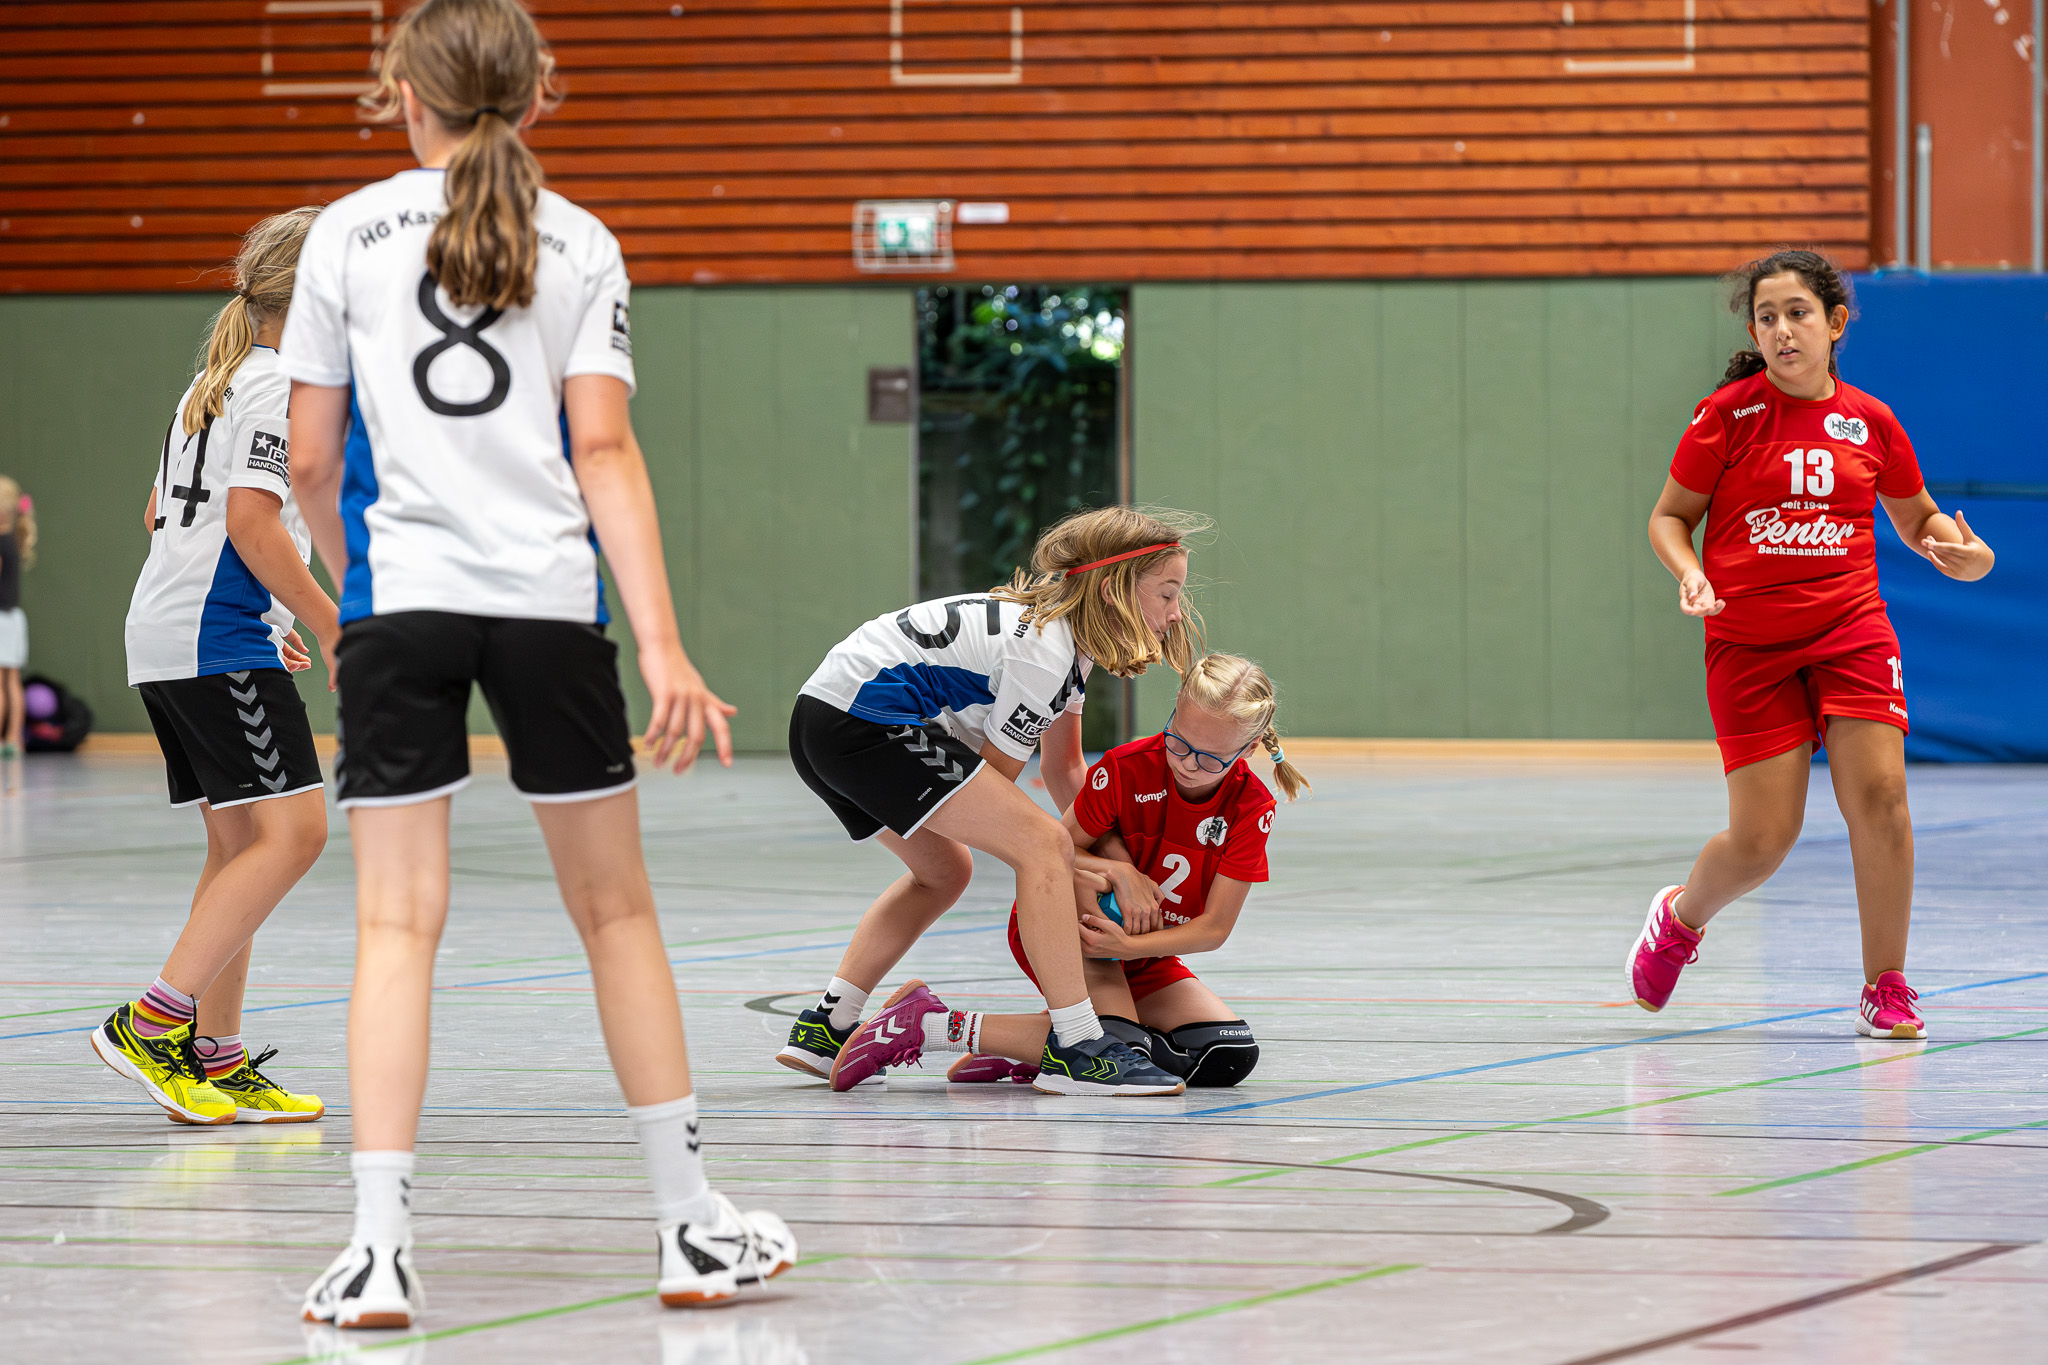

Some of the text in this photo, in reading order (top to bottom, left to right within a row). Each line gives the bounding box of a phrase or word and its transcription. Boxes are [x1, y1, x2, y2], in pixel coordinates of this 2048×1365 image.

[358, 221, 392, 249] HG
[398, 208, 443, 229] Kaa
[413, 270, 511, 416] 8
[1733, 402, 1767, 420] Kempa
[1783, 448, 1835, 497] 13
[1745, 507, 1855, 546] Benter
[1758, 544, 1848, 557] Backmanufaktur
[896, 599, 1001, 650] 5
[1134, 788, 1168, 804] Kempa
[1159, 853, 1191, 905] 2
